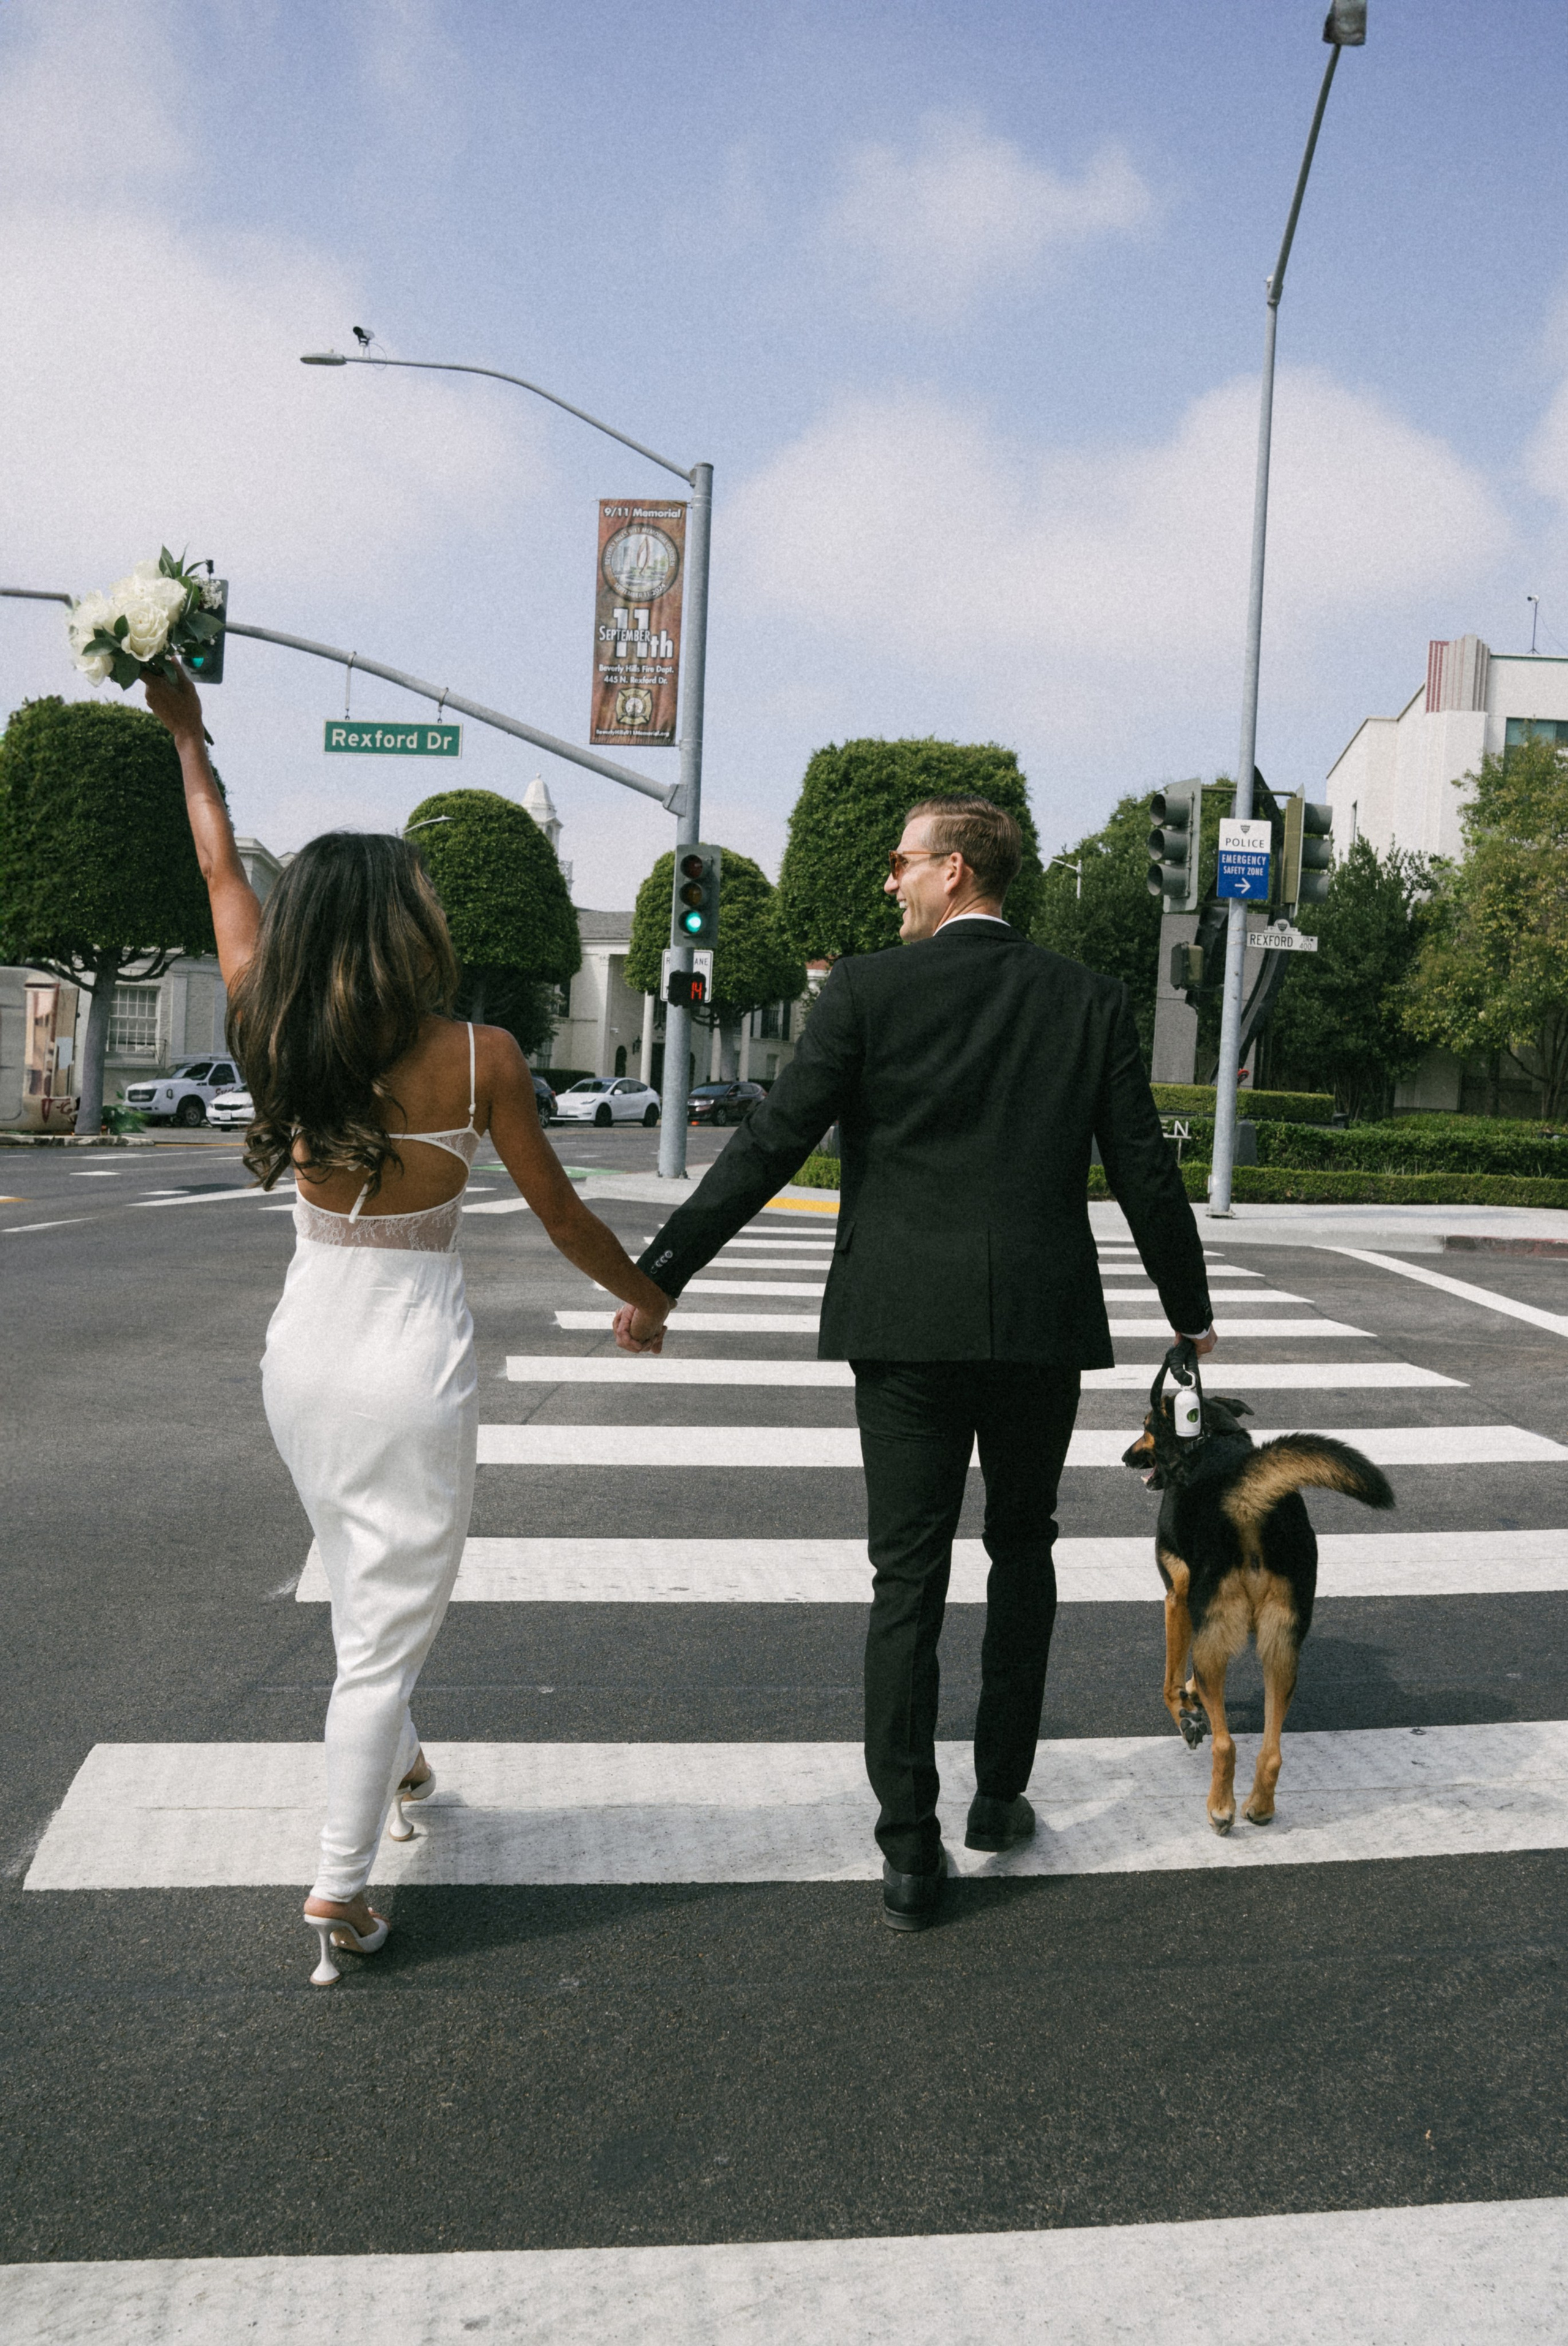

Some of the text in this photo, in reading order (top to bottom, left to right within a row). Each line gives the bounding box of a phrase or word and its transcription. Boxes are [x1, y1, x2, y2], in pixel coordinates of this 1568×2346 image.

[604, 507, 681, 518] 9/11 Memorial
[605, 542, 616, 565] BEVERLY
[641, 527, 668, 544] MEMORIAL
[614, 583, 642, 598] SEPTEMBER
[651, 583, 666, 596] 2024
[598, 664, 624, 674] Beverly
[656, 665, 674, 674] Dept.
[331, 729, 452, 750] Rexford Dr
[1226, 837, 1264, 848] POLICE
[1221, 854, 1266, 866] EMERGENCY
[1223, 866, 1264, 876] SAFETY ZONE
[1250, 933, 1294, 948] REXFORD
[691, 982, 703, 999] 14
